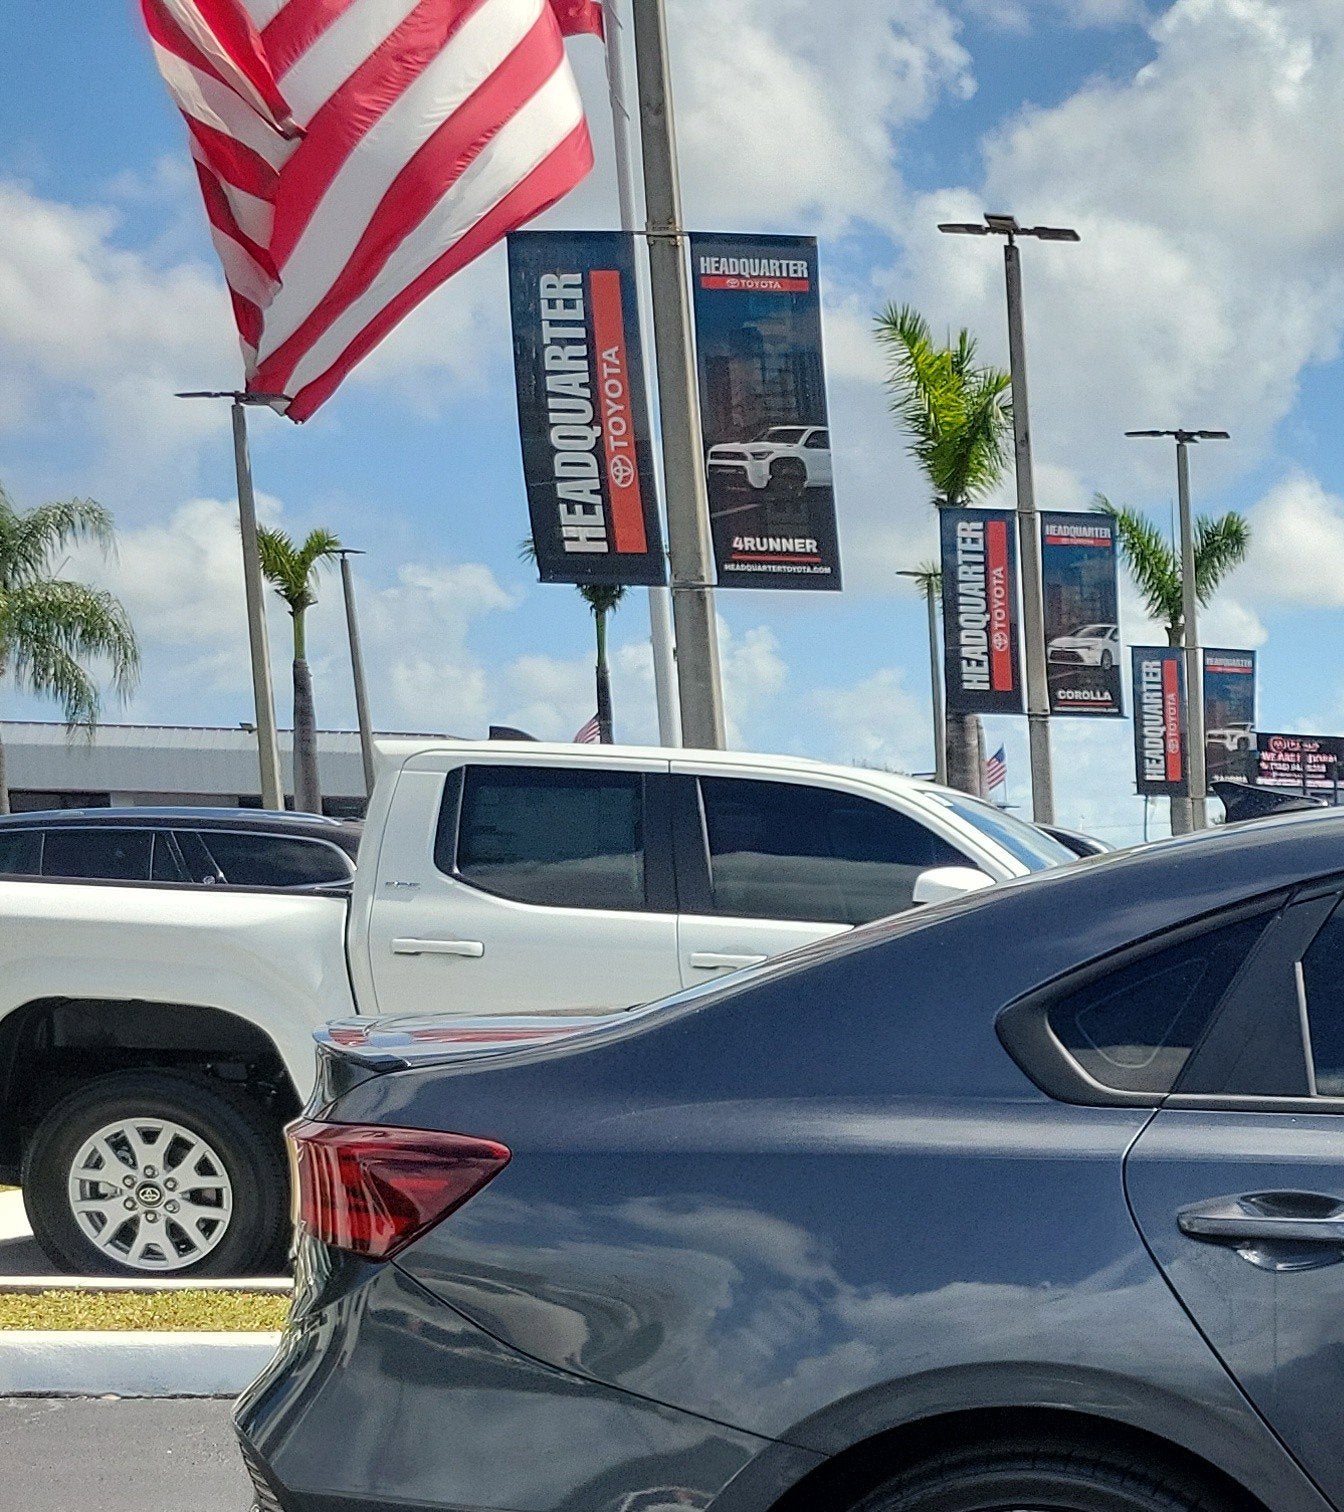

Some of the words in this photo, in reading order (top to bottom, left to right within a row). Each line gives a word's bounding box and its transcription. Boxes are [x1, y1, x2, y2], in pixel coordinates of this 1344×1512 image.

[699, 256, 809, 279] HEADQUARTER
[740, 278, 782, 290] TOYOTA
[540, 272, 609, 554] HEADQUARTER
[602, 346, 630, 448] TOYOTA
[732, 537, 818, 554] 4RUNNER
[956, 521, 991, 691] HEADQUARTER
[991, 566, 1006, 634] TOYOTA
[1057, 689, 1112, 701] COROLLA
[1141, 660, 1166, 781] HEADQUARTER
